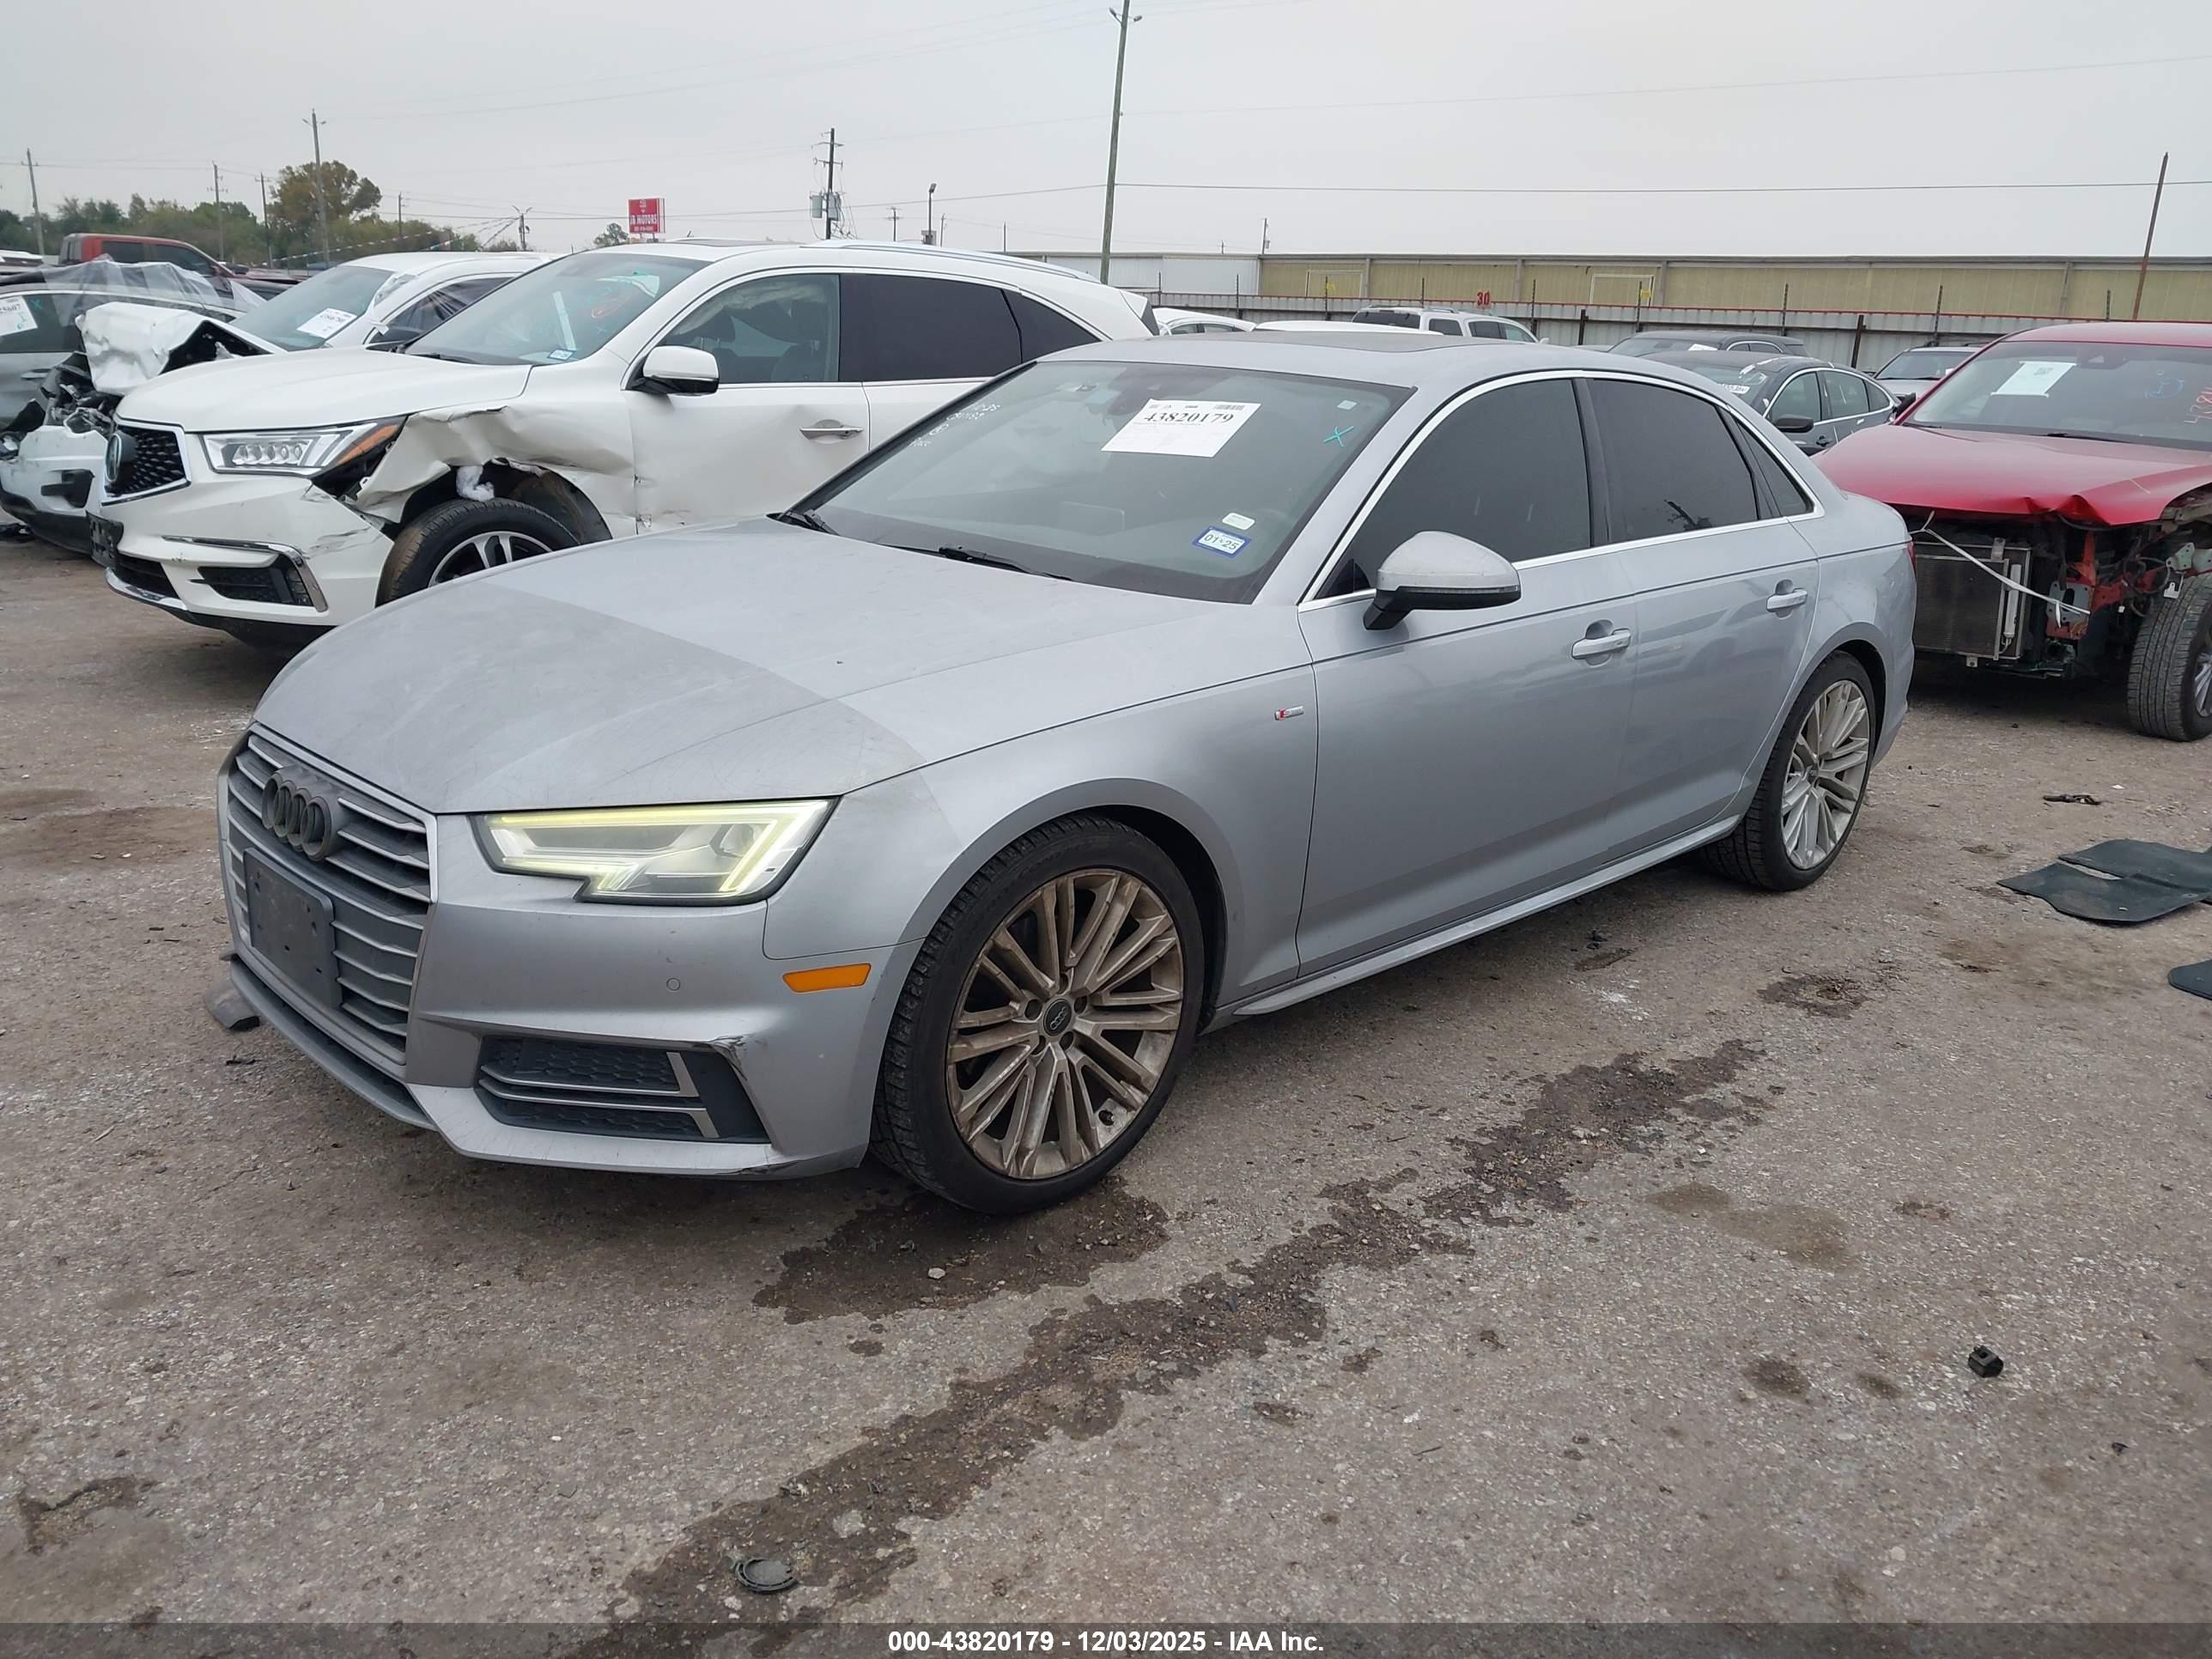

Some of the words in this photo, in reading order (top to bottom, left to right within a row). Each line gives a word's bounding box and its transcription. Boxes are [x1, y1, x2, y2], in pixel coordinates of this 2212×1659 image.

[637, 214, 658, 224] MOTORS
[1476, 290, 1491, 306] 30
[1144, 411, 1235, 424] 43820179
